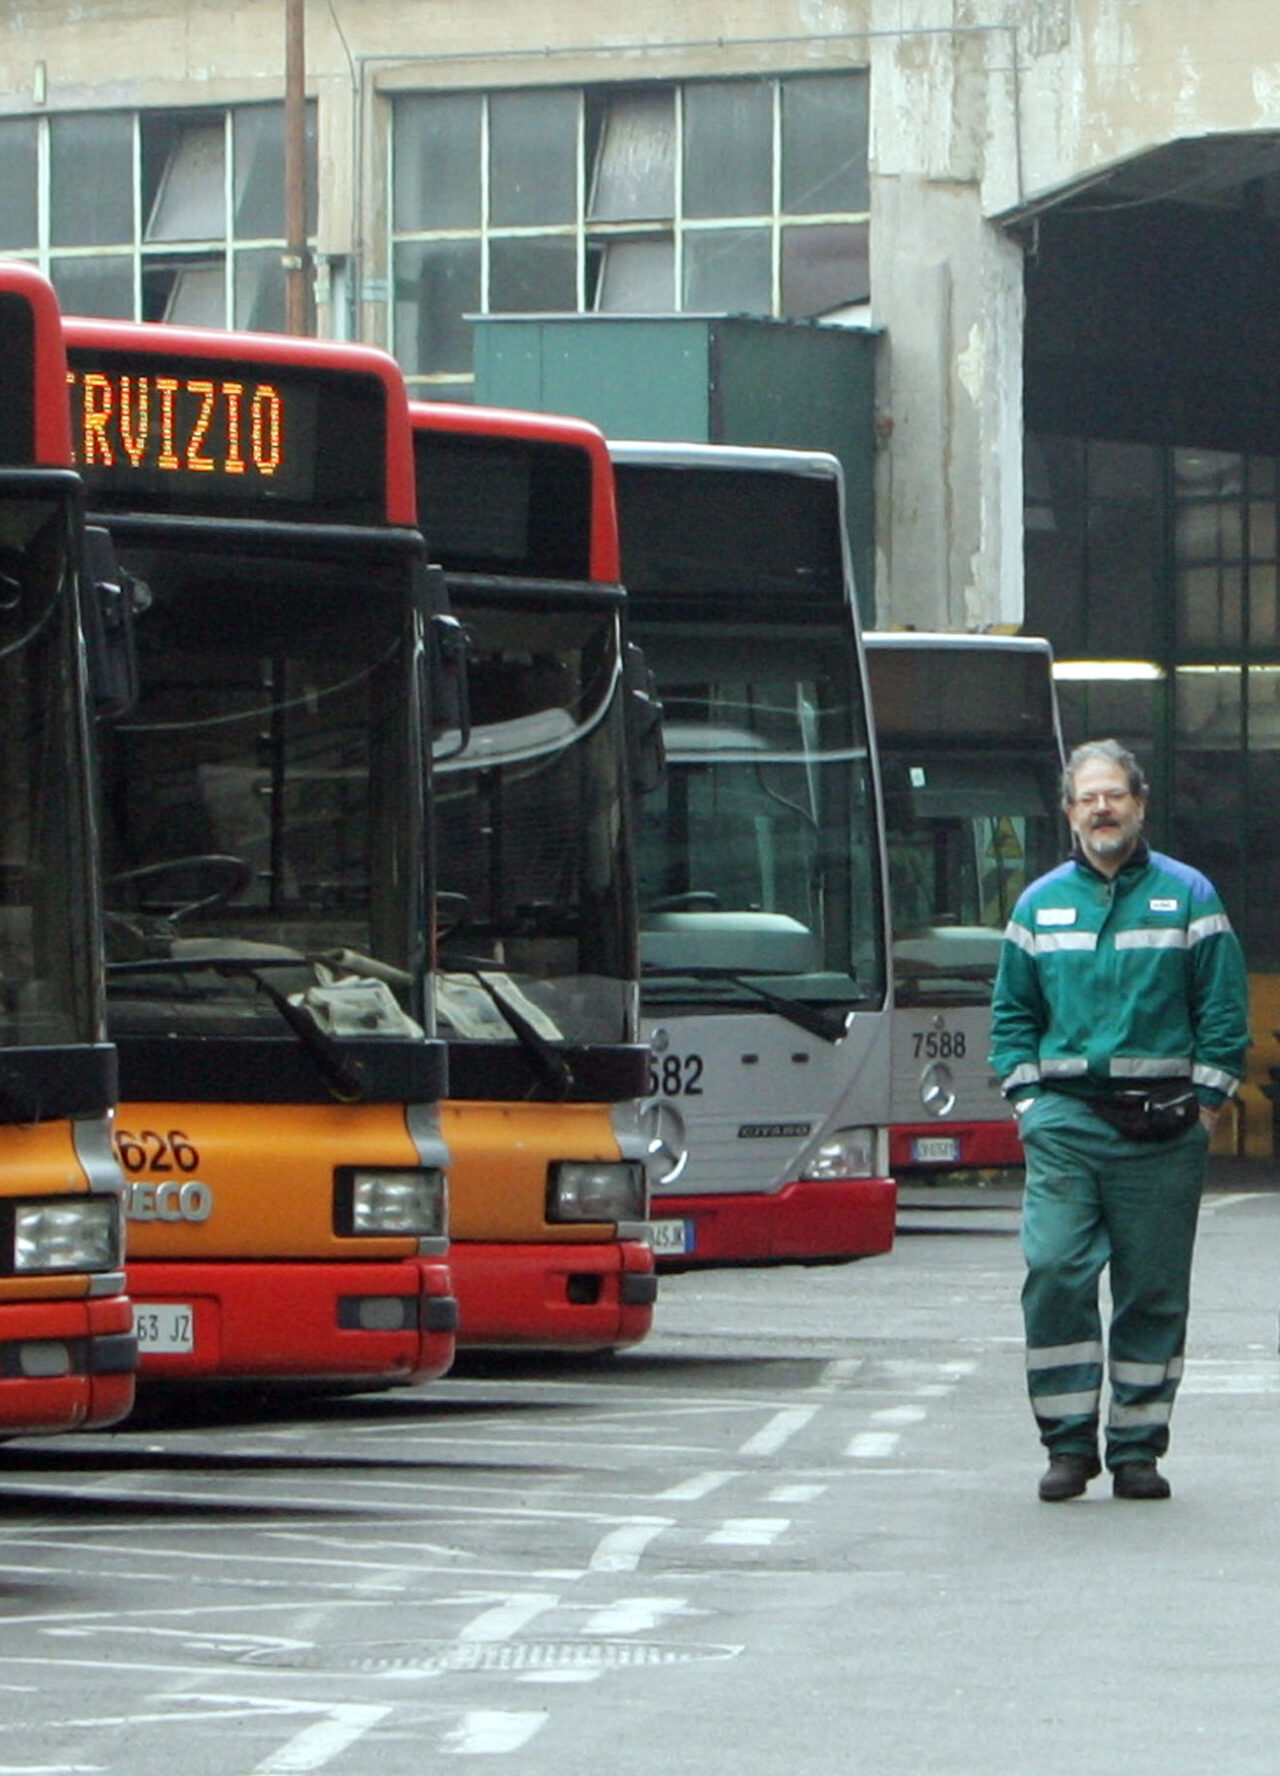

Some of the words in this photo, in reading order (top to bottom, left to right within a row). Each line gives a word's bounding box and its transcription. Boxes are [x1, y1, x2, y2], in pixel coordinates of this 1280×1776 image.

[66, 372, 282, 475] RVIZIO
[912, 1031, 966, 1059] 7588
[112, 1129, 200, 1173] 626
[122, 1181, 213, 1223] ECO
[170, 1314, 191, 1342] JZ
